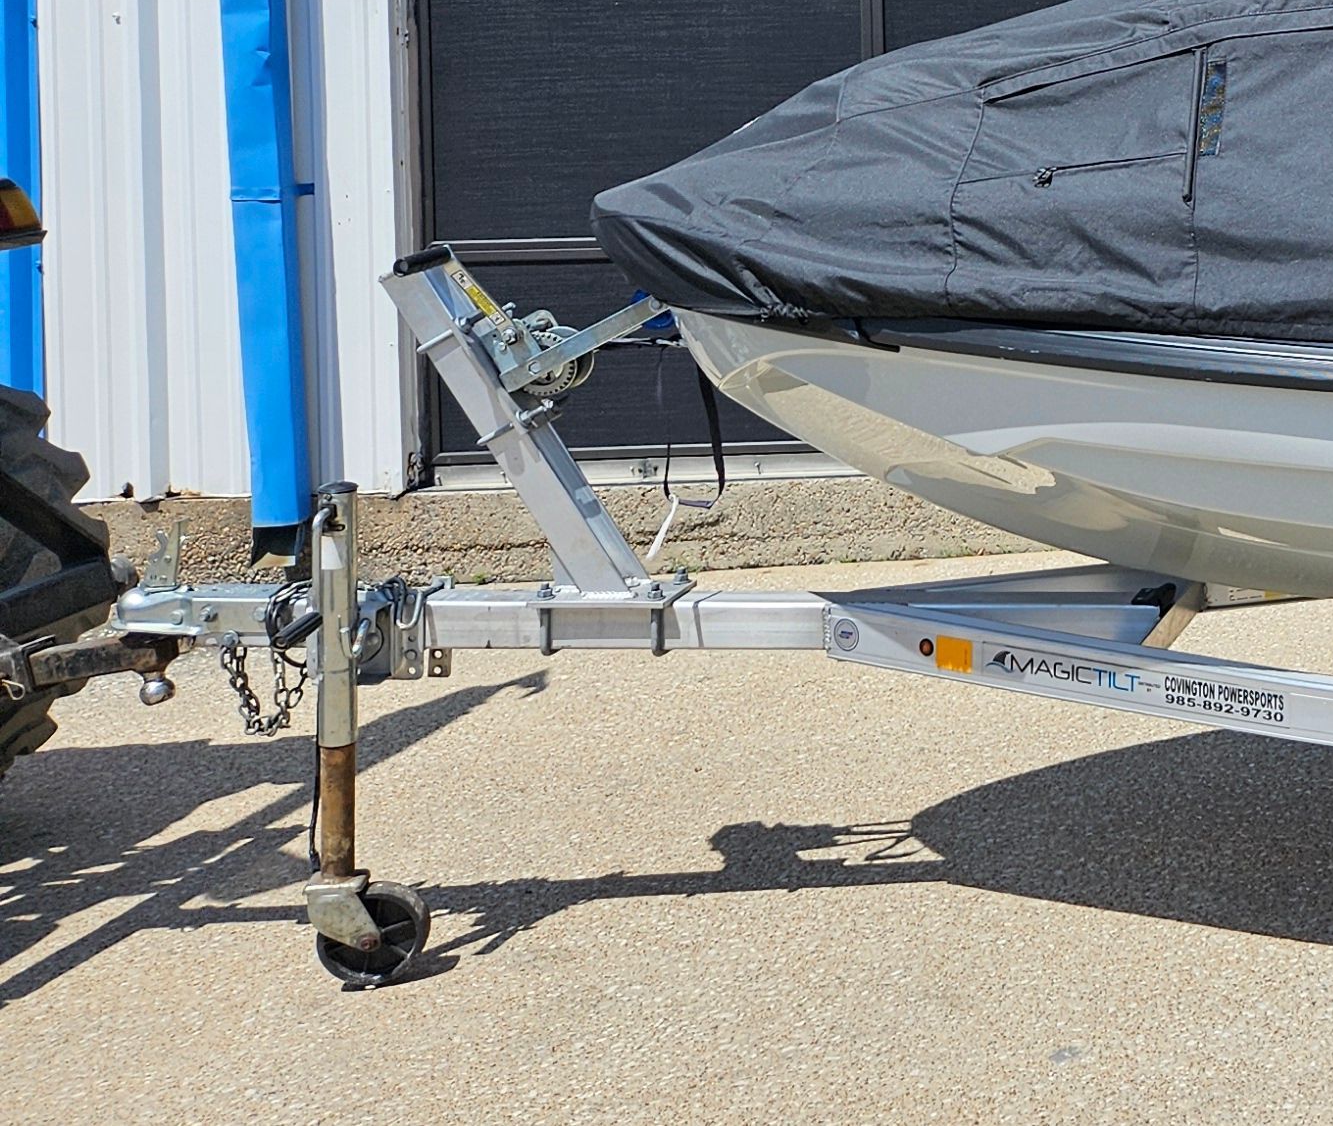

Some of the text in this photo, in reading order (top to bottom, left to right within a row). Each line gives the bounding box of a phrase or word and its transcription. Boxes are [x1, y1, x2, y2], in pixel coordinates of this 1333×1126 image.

[1164, 675, 1285, 712] COVINGTON POWERSPORTS
[1164, 693, 1285, 723] 985-892-9730
